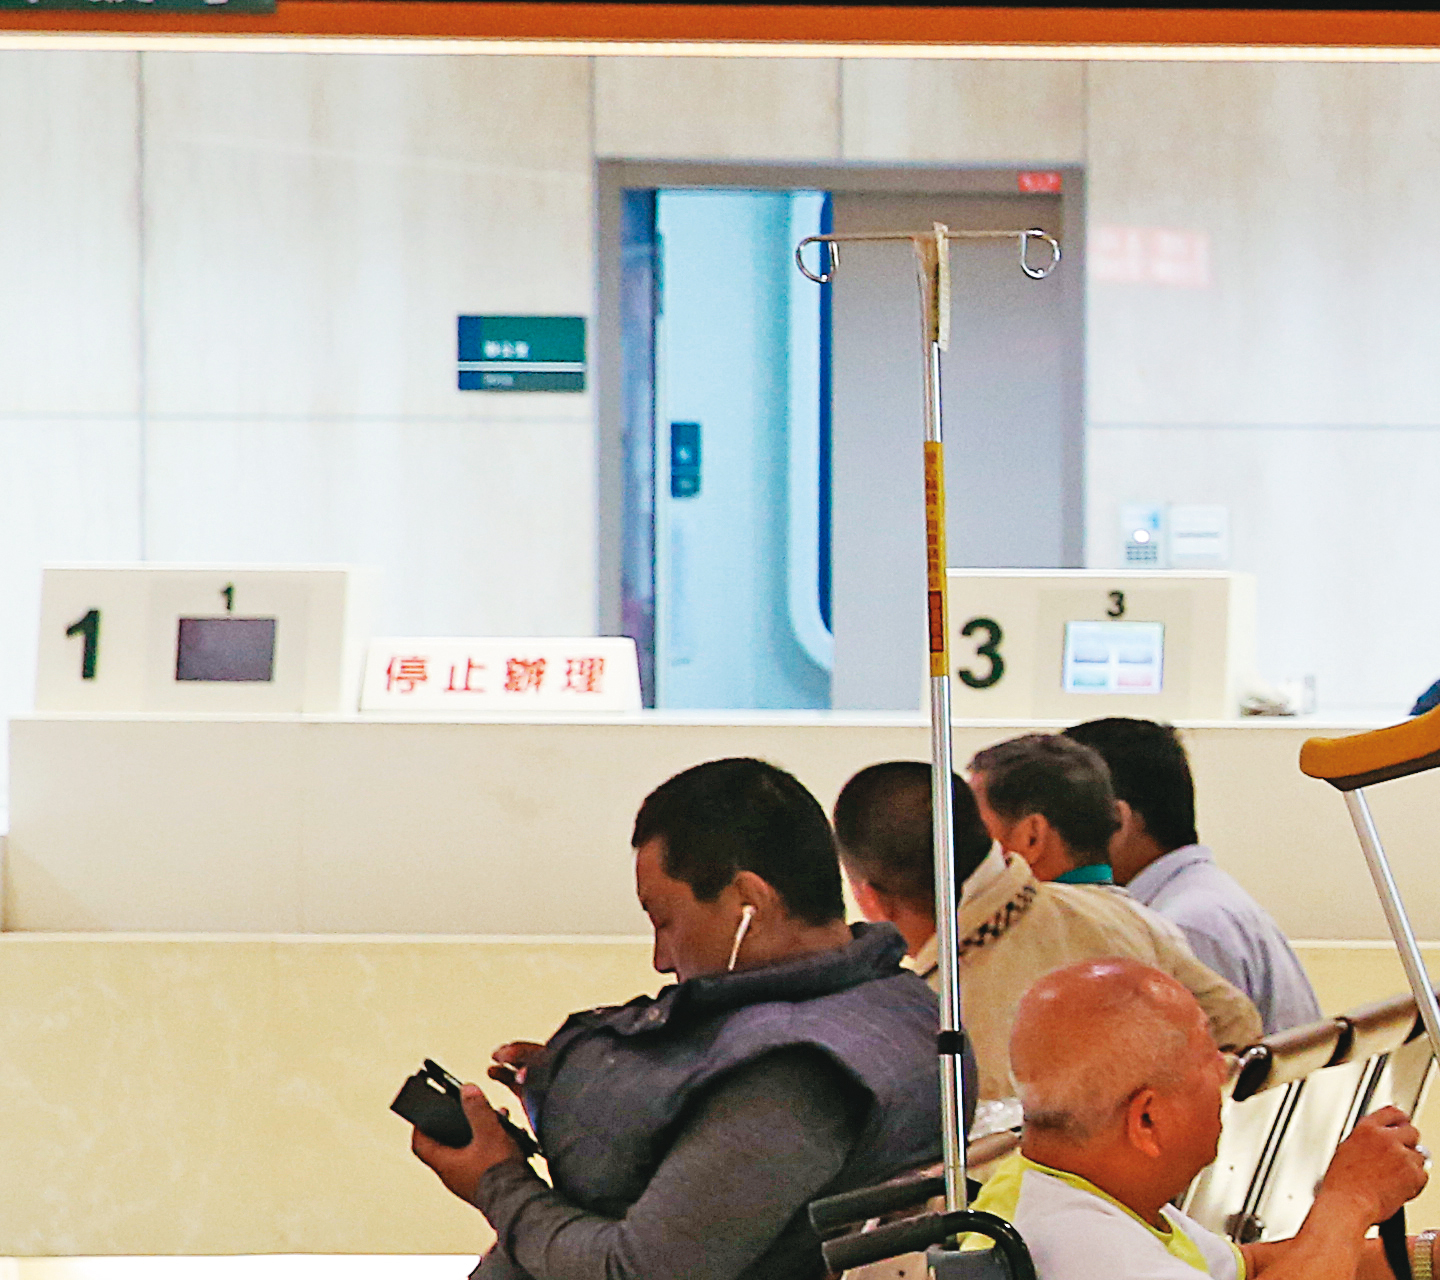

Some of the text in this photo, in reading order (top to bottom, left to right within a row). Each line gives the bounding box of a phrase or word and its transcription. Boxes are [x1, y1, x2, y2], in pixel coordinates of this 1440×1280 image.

[220, 582, 234, 611] 1
[1106, 590, 1125, 617] 3
[66, 609, 100, 680] 1
[957, 617, 1007, 690] 3
